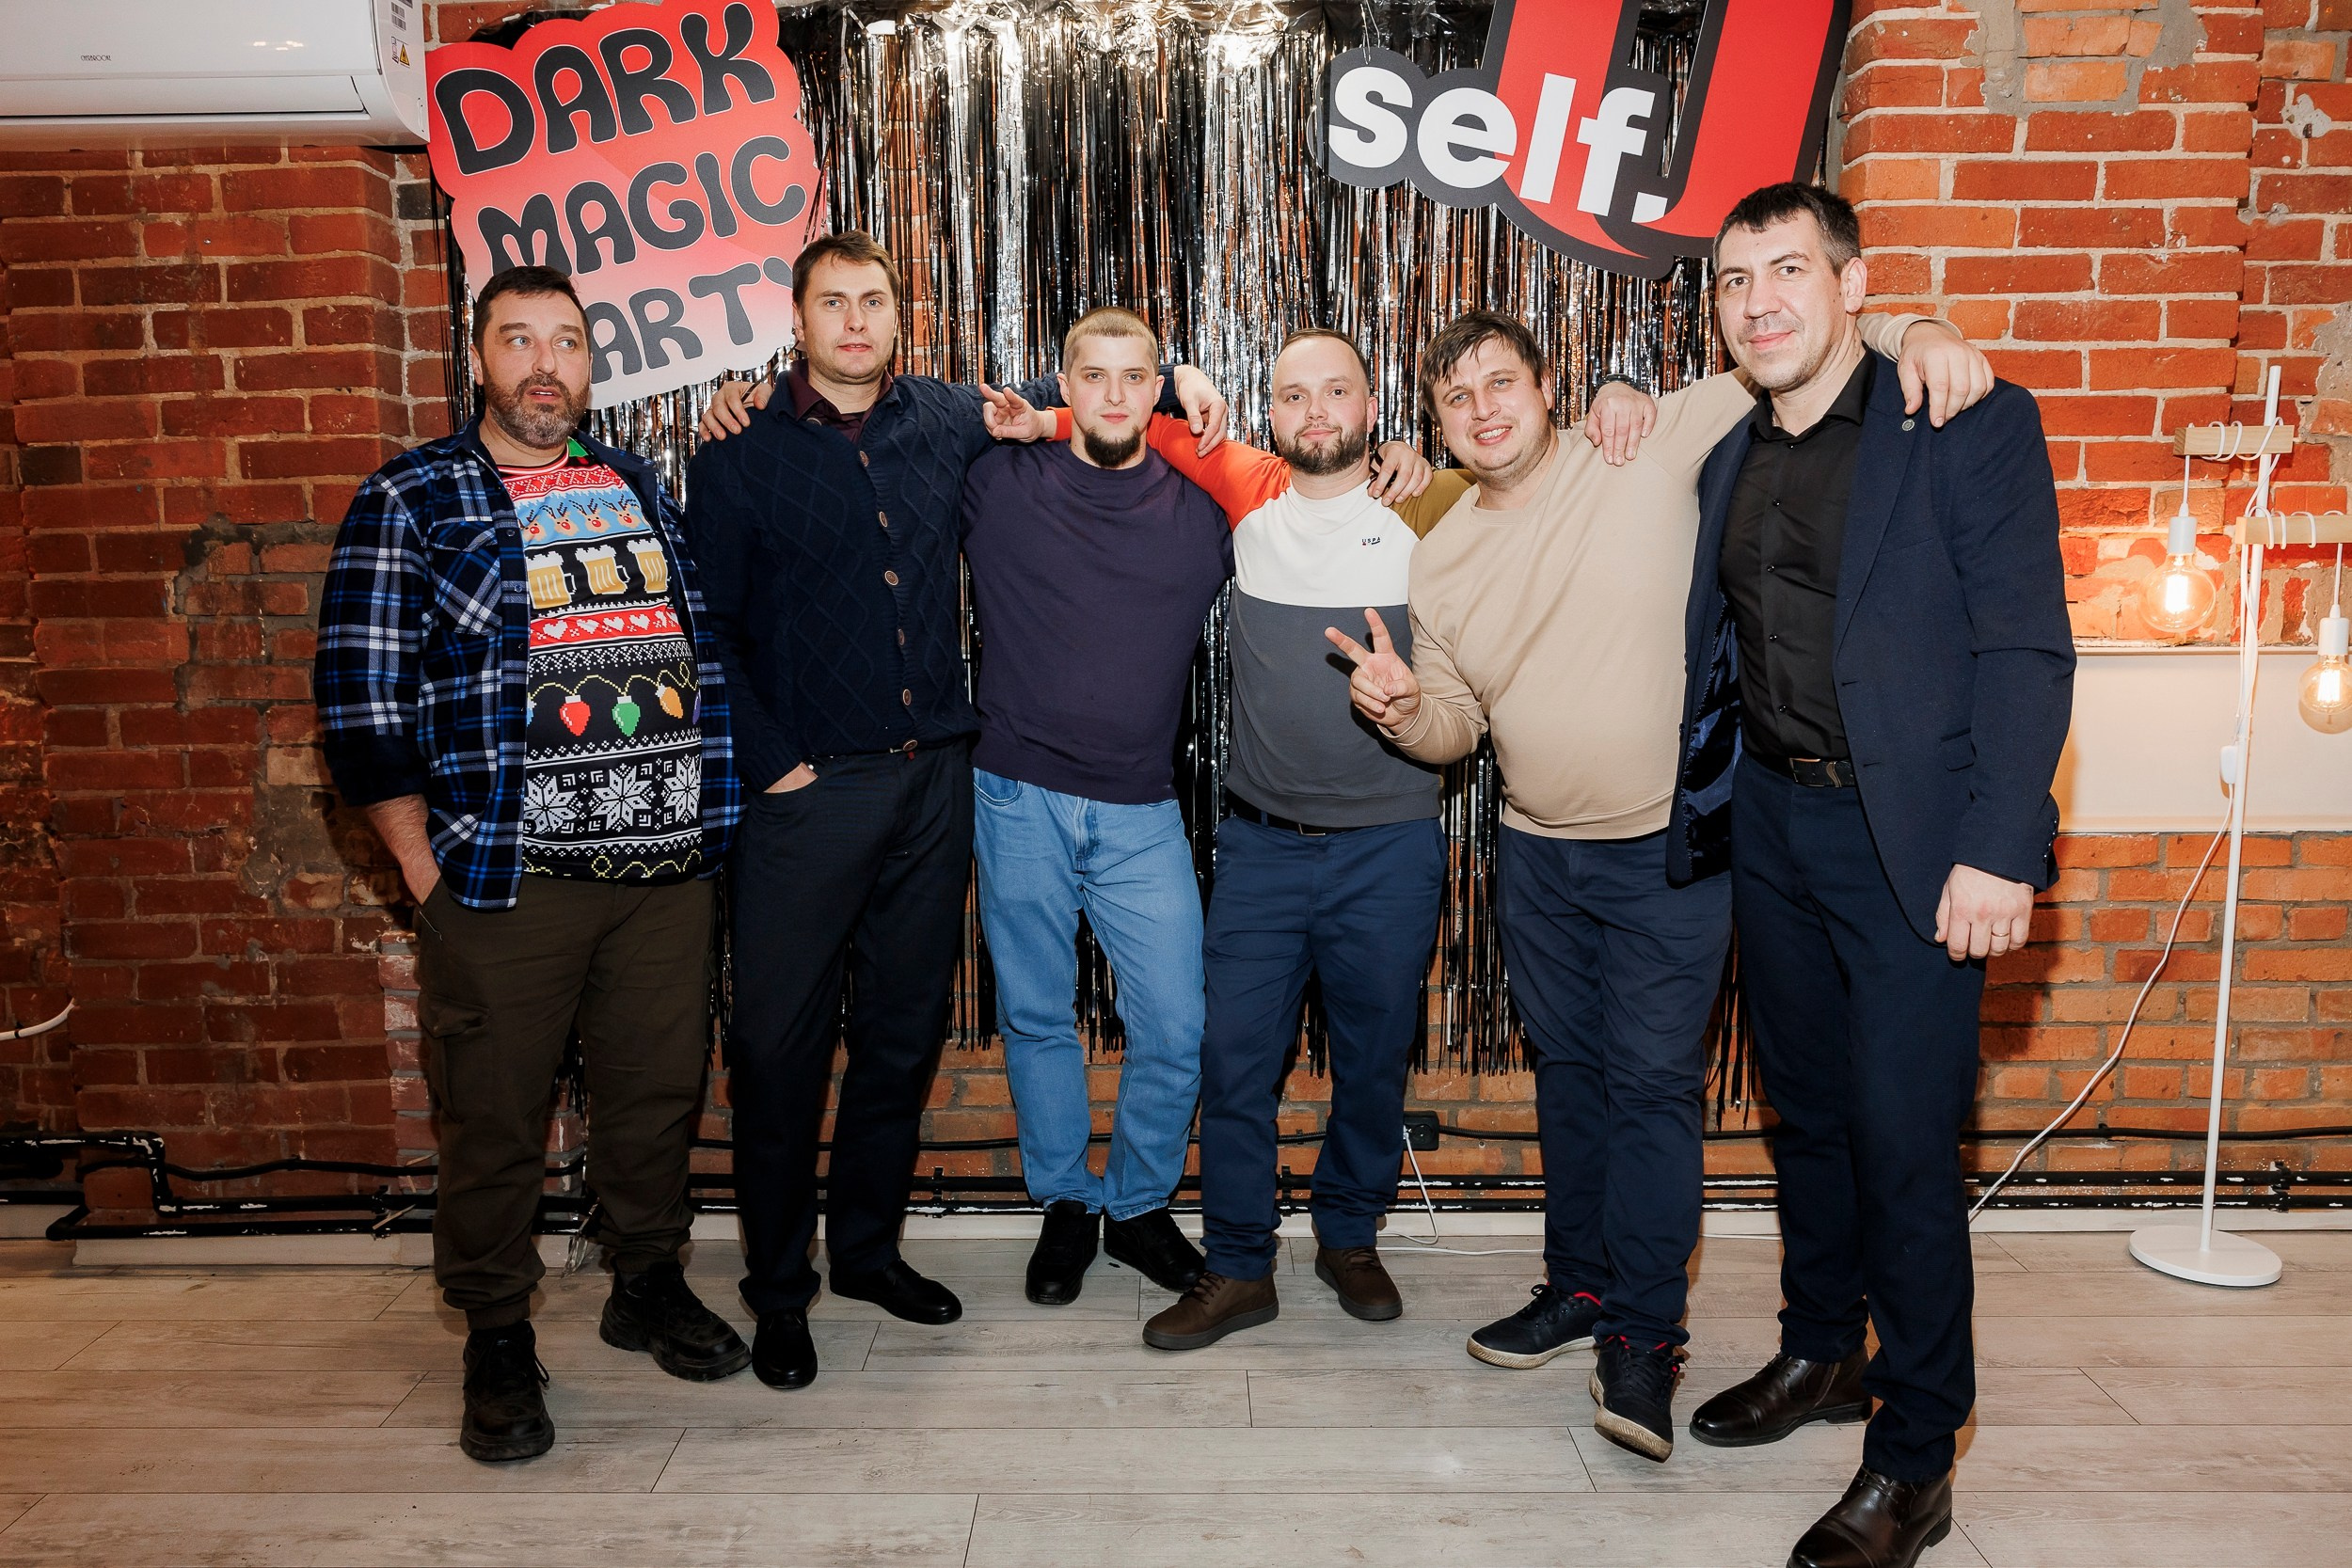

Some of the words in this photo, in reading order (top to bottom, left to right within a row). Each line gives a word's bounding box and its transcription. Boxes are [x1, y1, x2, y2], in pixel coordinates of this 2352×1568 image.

[435, 2, 776, 177] DARK
[1328, 66, 1668, 223] self.
[477, 135, 807, 277] MAGIC
[591, 256, 794, 385] ART
